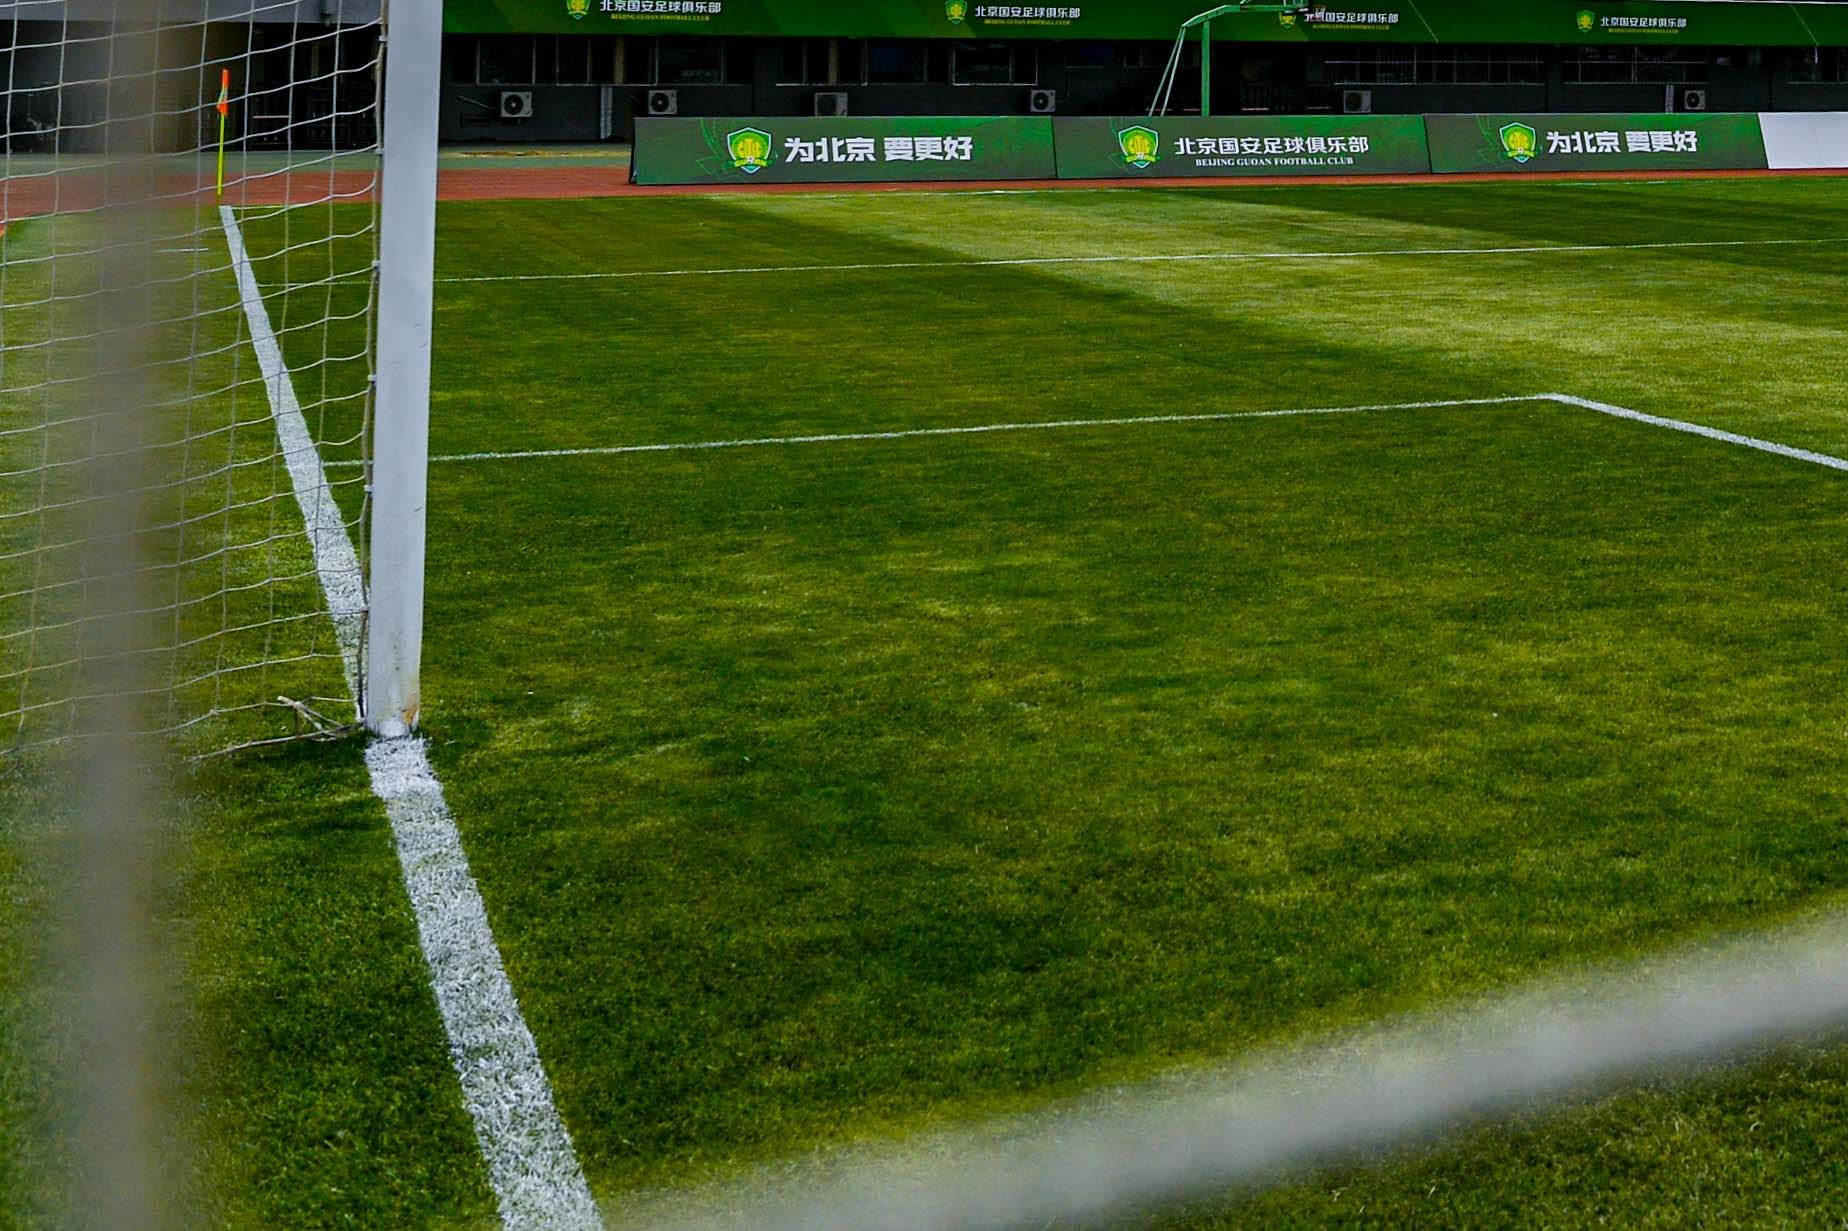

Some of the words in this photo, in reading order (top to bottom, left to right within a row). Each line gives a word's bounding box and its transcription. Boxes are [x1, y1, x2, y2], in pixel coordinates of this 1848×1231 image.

[600, 0, 722, 14] 北京国安足球俱乐部
[975, 5, 1081, 19] 北京国安足球俱乐部
[1600, 16, 1687, 28] 北京国安足球俱乐部
[1174, 136, 1369, 155] 北京国安足球俱乐部
[1546, 131, 1621, 153] 为北京
[1625, 130, 1698, 152] 要更好
[784, 136, 876, 163] 为北京
[884, 136, 973, 161] 要更好
[1195, 158, 1235, 167] BEIJING
[1237, 158, 1272, 166] GUOAN
[1274, 157, 1326, 166] FOOTBALL
[1327, 156, 1354, 165] CLUB
